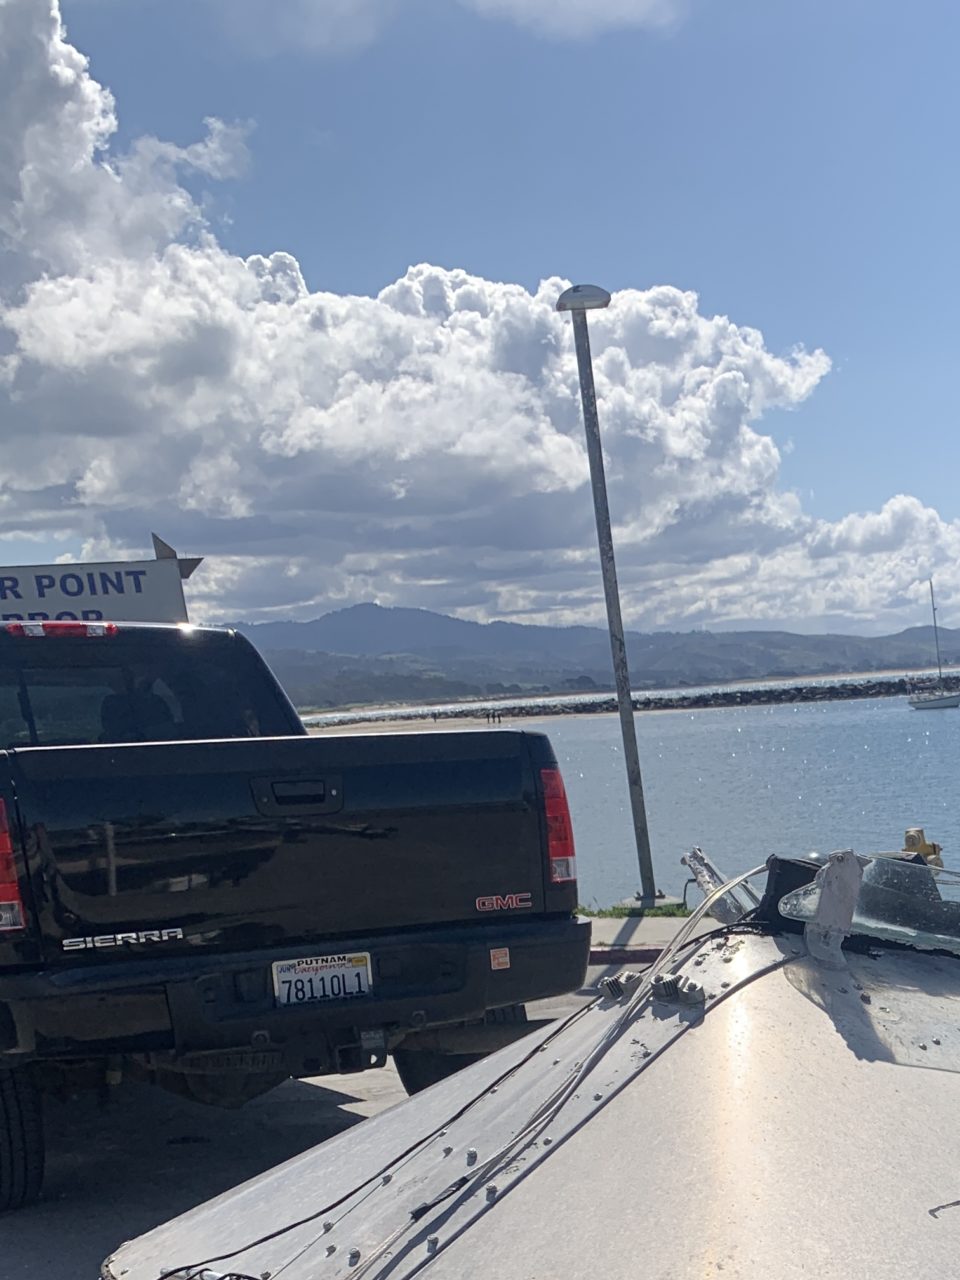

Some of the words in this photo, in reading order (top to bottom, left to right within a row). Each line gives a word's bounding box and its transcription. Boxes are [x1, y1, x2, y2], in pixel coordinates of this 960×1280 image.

[34, 570, 147, 599] POINT
[476, 893, 532, 911] GMC
[62, 928, 184, 951] SIERRA
[297, 955, 347, 967] PUTNAM
[281, 971, 366, 1004] 78110L1
